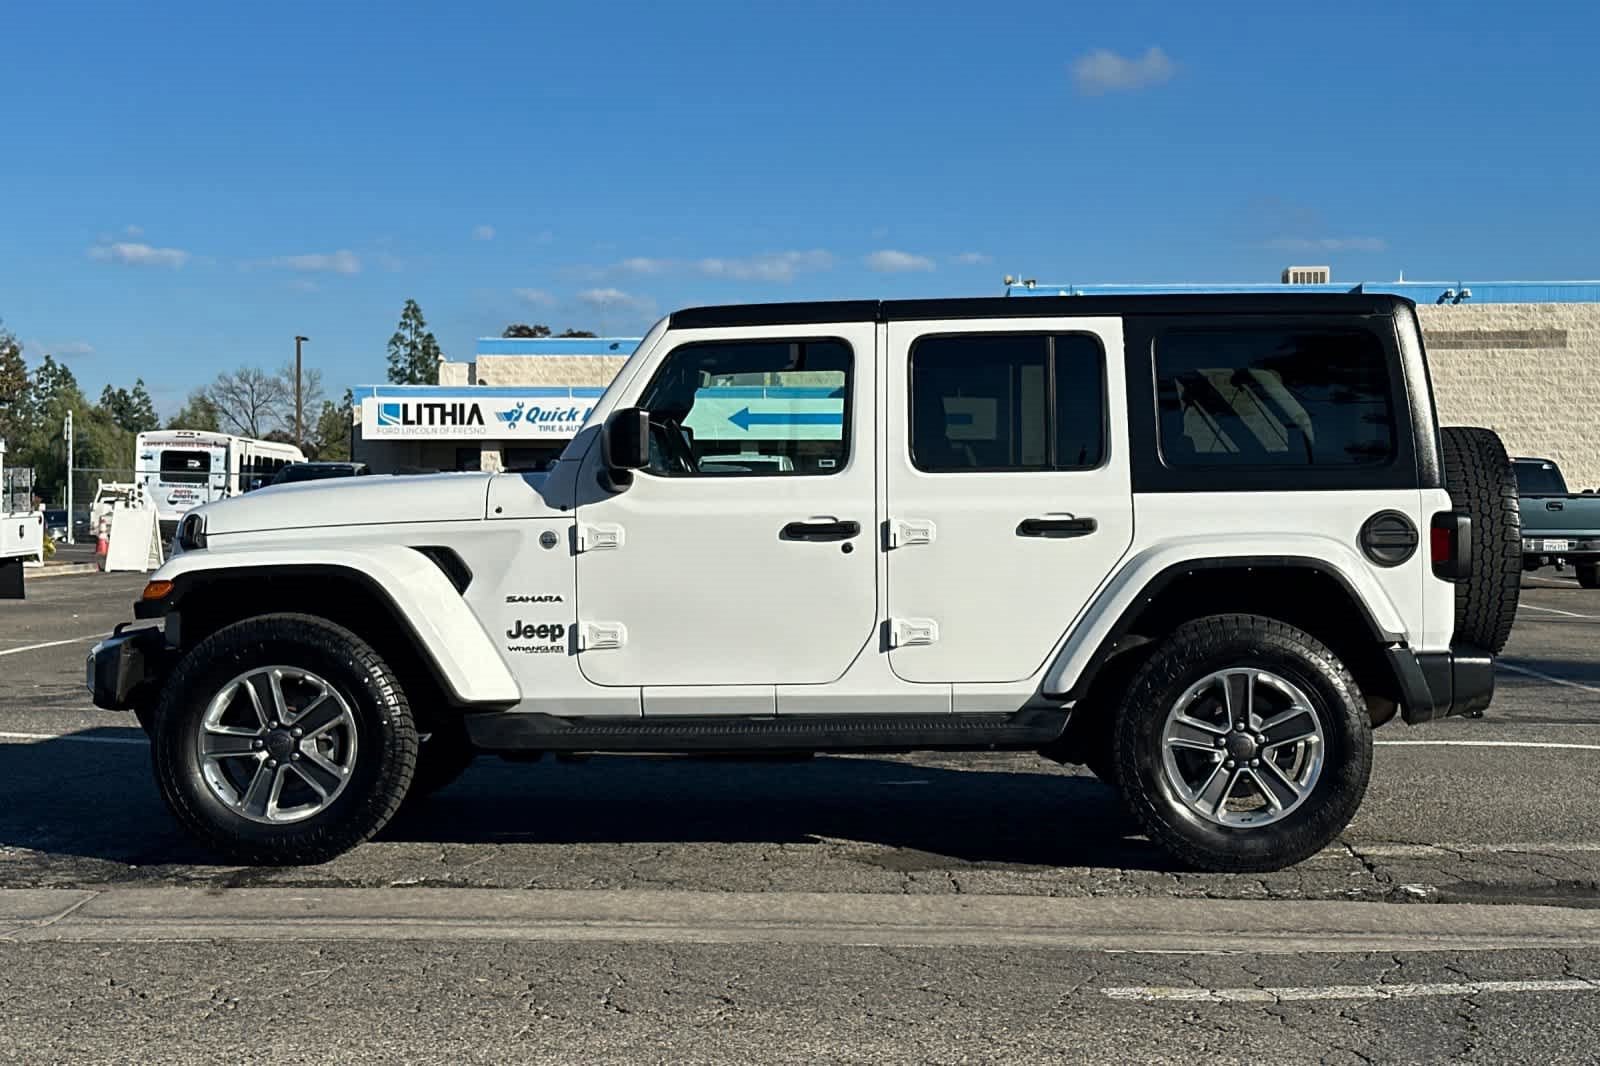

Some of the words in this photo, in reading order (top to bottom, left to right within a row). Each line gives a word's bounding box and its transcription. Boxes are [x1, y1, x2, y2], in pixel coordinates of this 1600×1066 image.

[402, 403, 485, 426] LITHIA
[526, 407, 580, 424] Quick
[376, 427, 400, 436] FORD
[401, 427, 438, 436] LINCOLN
[440, 427, 450, 436] OF
[452, 427, 487, 436] FRESNO
[538, 425, 557, 433] TIRE
[558, 425, 565, 433] &
[506, 595, 563, 603] SAHARA
[506, 620, 565, 642] Jeep
